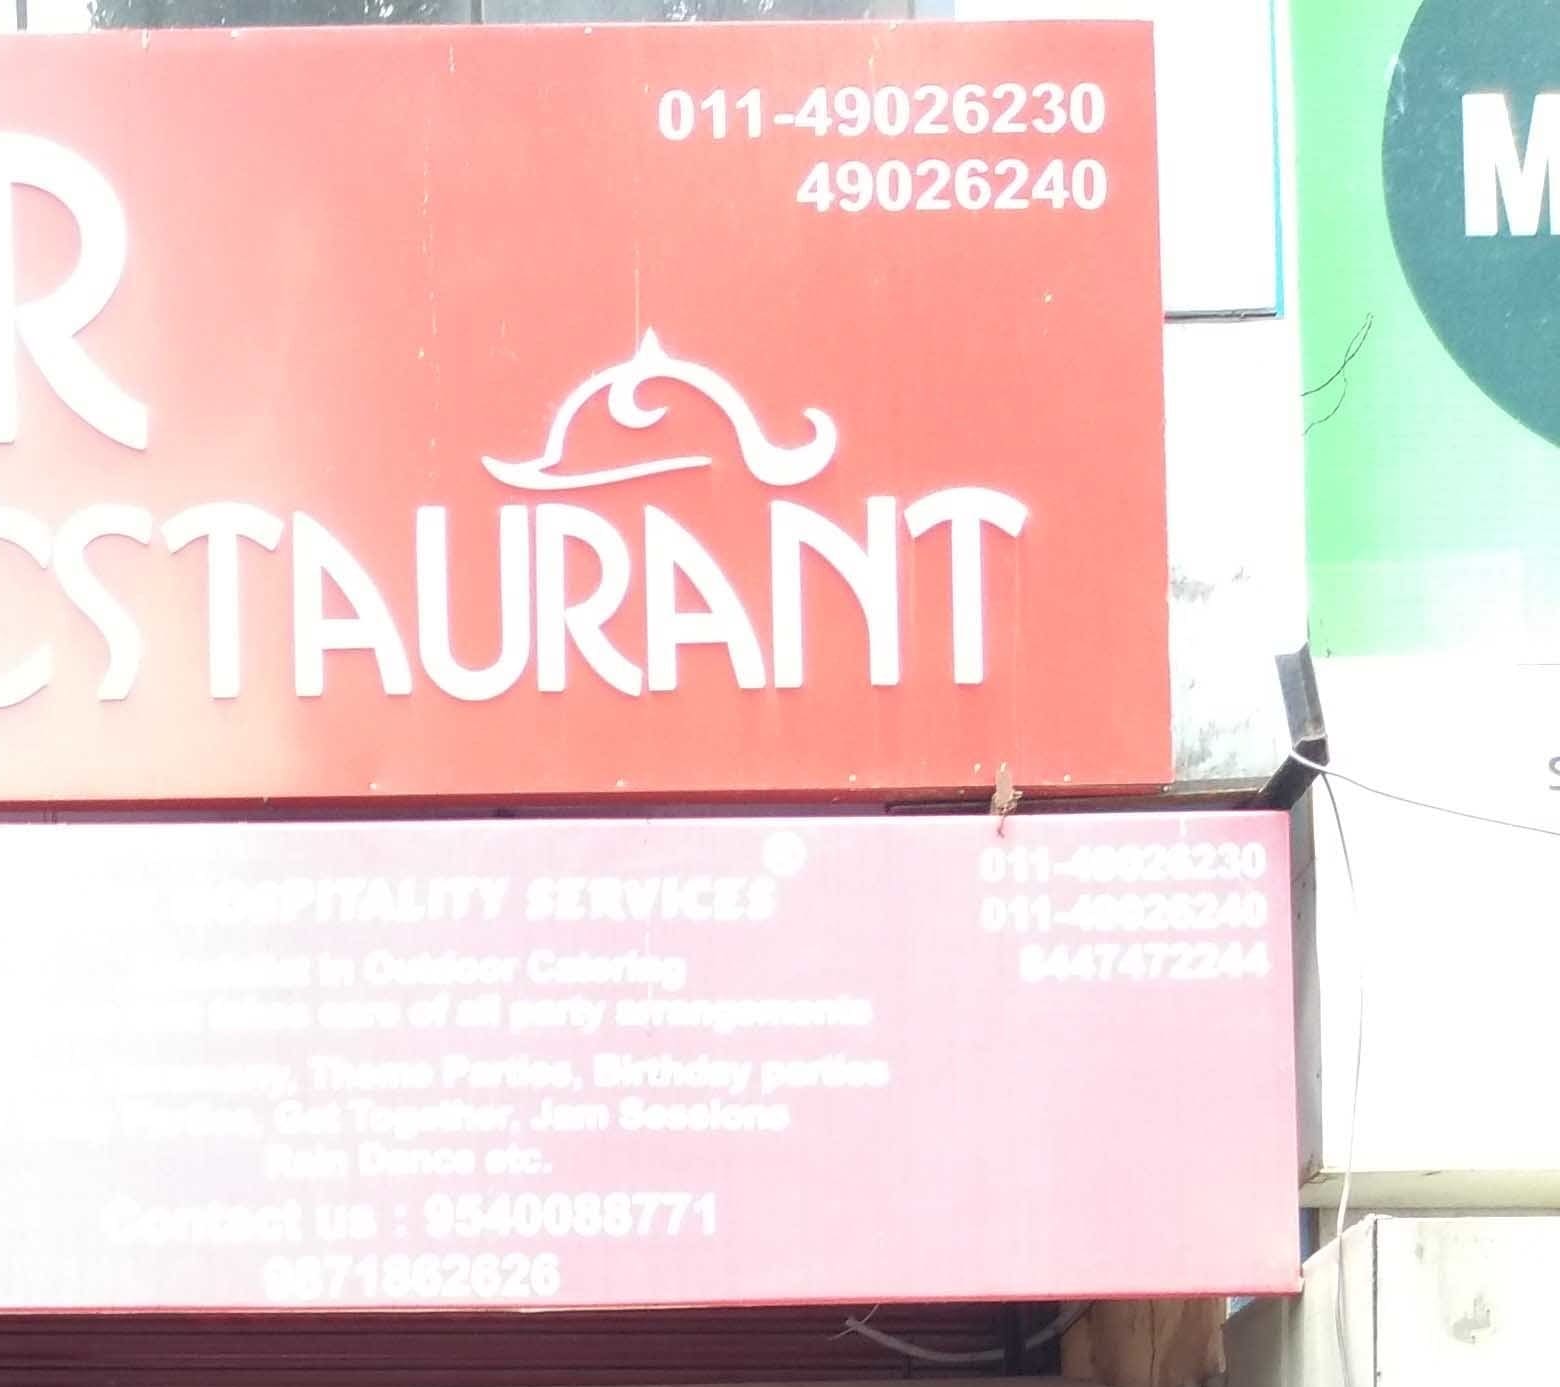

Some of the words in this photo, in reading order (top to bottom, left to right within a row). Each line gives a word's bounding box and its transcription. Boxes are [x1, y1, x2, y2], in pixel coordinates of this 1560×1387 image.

[656, 81, 1106, 141] 011-49026230
[795, 156, 1108, 213] 49026240
[527, 875, 781, 921] SERVICES
[528, 950, 686, 990] Catering
[510, 999, 605, 1035] party
[592, 1053, 751, 1094] Birthday
[760, 1055, 890, 1093] parties
[529, 1098, 608, 1132] Jam
[619, 1096, 792, 1132] Sessions
[484, 1146, 552, 1176] etc.
[315, 1201, 377, 1240] us
[423, 1192, 718, 1238] 9540088771
